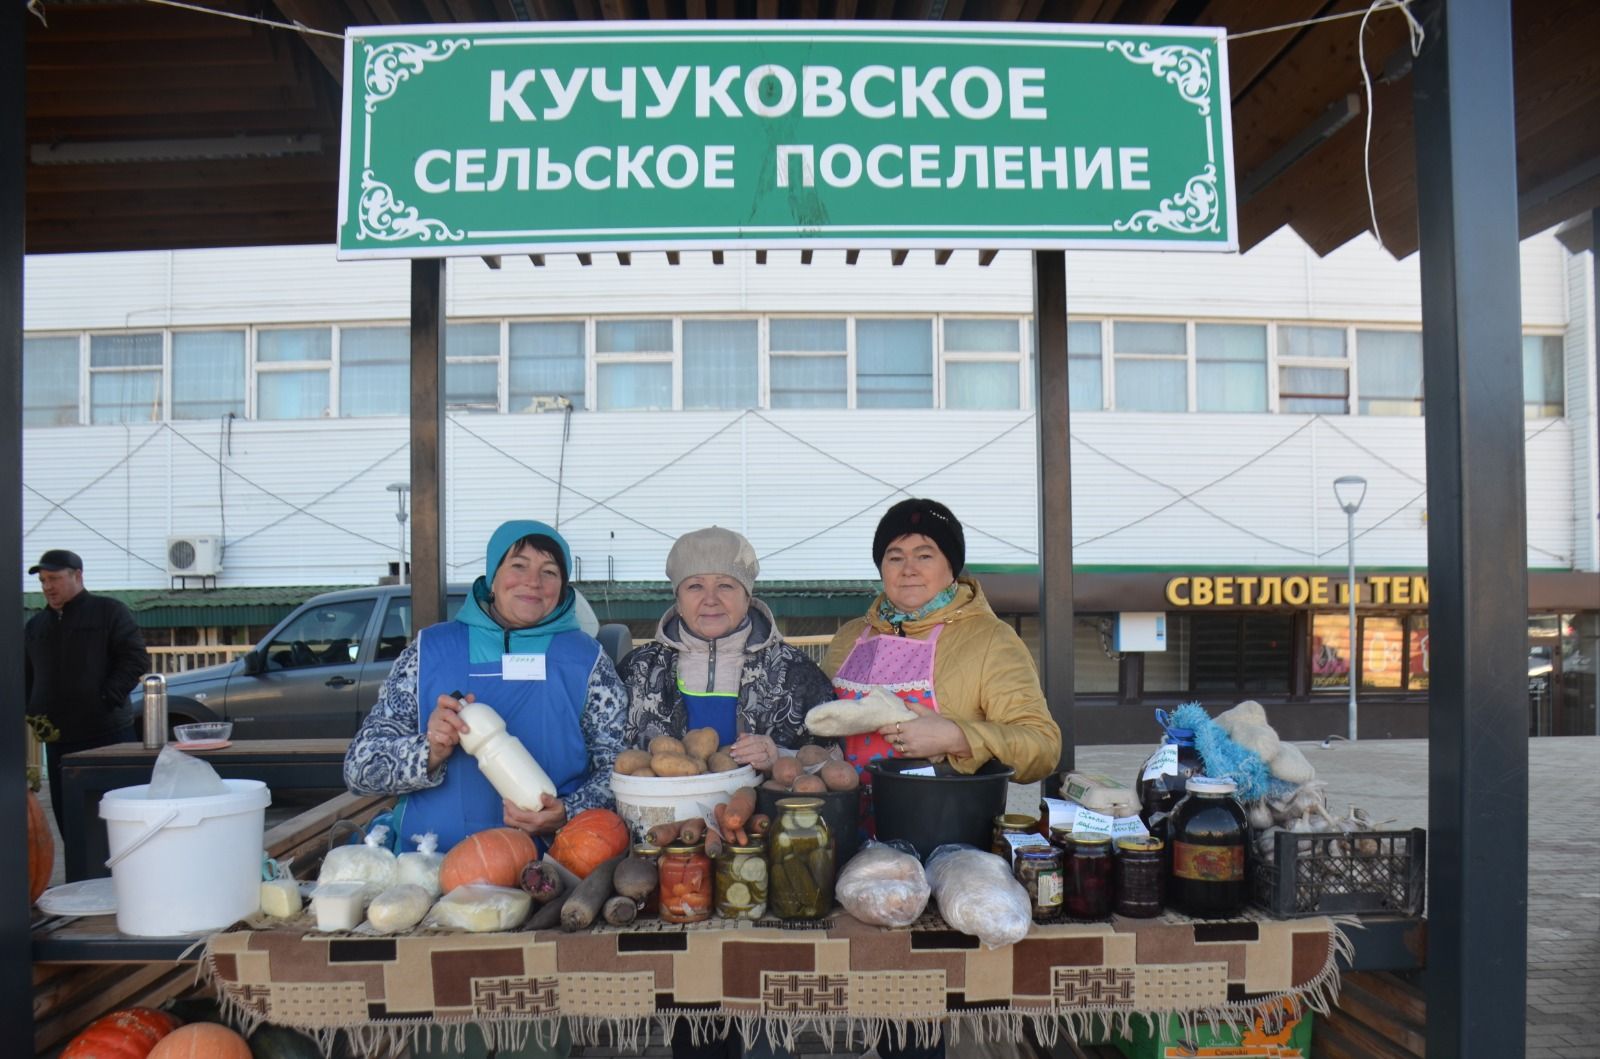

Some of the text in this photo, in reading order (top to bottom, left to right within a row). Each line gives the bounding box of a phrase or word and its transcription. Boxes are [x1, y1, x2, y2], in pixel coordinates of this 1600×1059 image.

[489, 64, 1048, 123] КУЧУКОВСКОЕ
[414, 142, 1151, 195] СЕЛЬСКОЕ ПОСЕЛЕНИЕ
[1166, 576, 1329, 606] СВЕТЛОЕ
